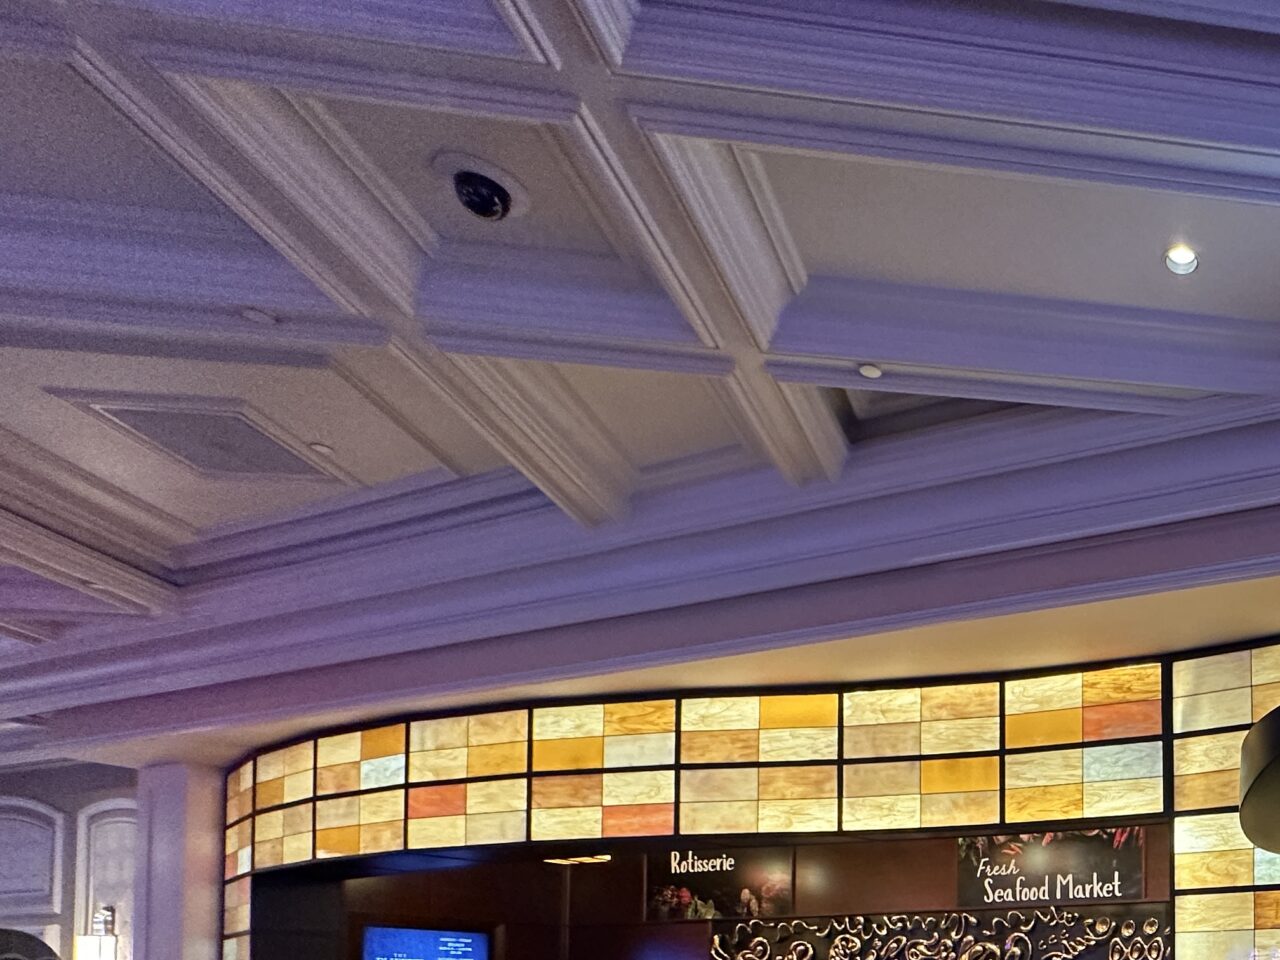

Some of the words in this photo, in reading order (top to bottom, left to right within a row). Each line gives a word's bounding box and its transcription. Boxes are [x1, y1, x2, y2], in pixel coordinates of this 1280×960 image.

[671, 850, 735, 874] Rotisserie
[977, 857, 1020, 878] Fresh
[984, 874, 1050, 903] Seafood
[1056, 871, 1122, 900] Market
